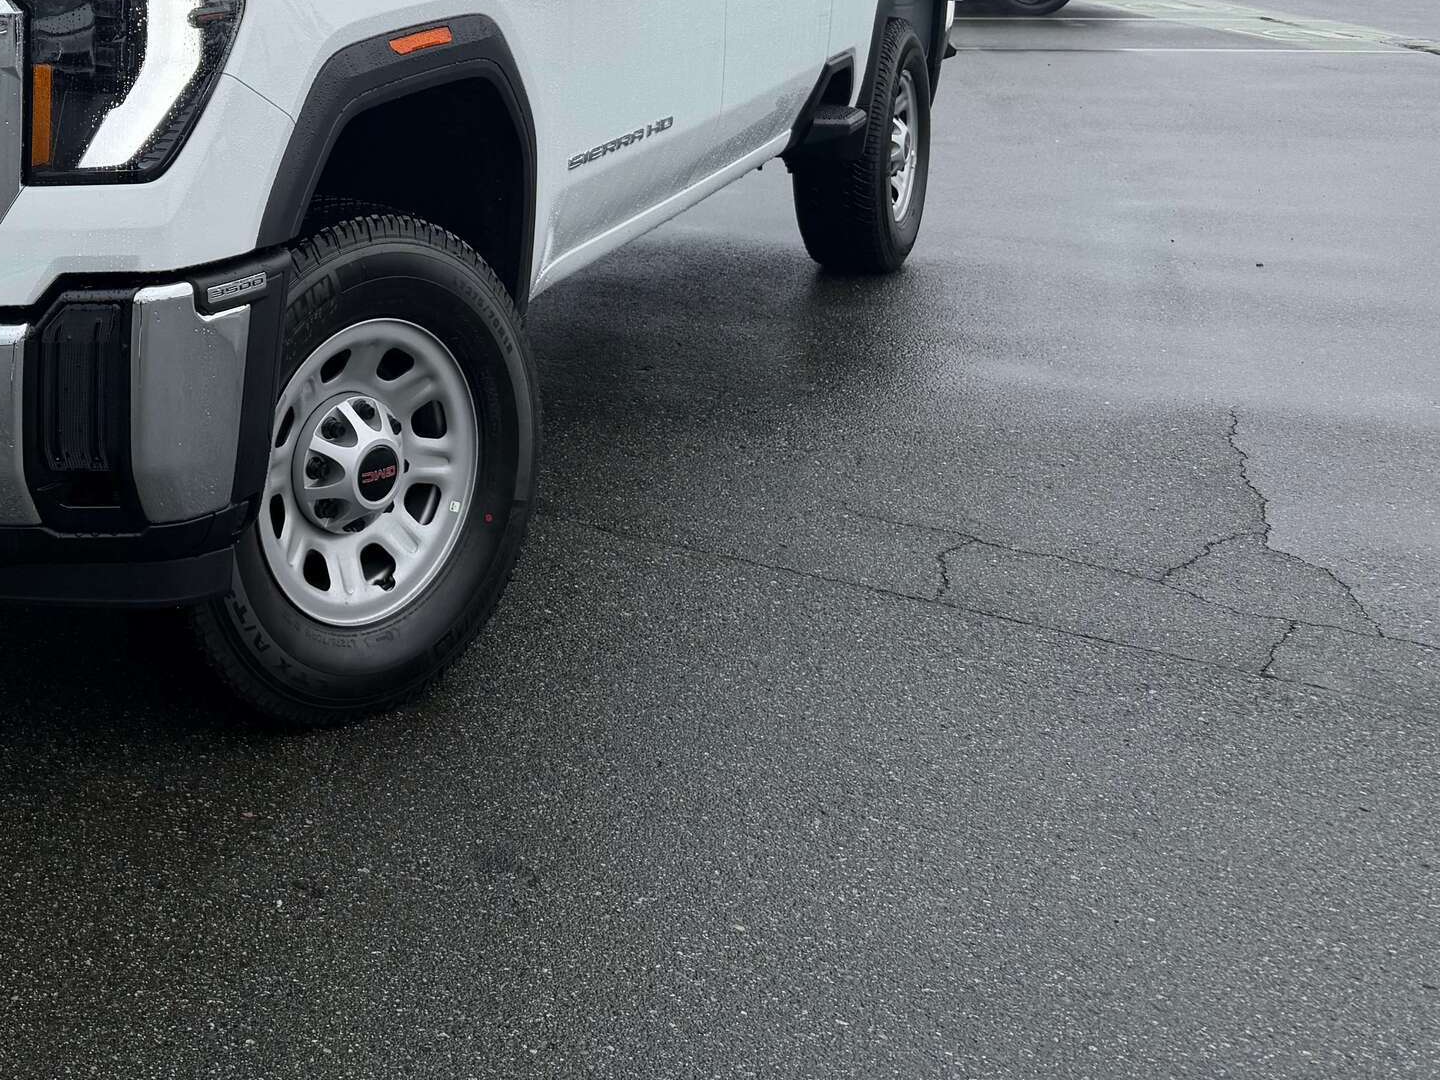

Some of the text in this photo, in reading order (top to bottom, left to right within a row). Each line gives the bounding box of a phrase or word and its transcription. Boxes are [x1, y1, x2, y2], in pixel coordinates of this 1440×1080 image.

[567, 115, 674, 171] SIERRA HD
[210, 277, 264, 300] 3500
[361, 464, 397, 484] GMC
